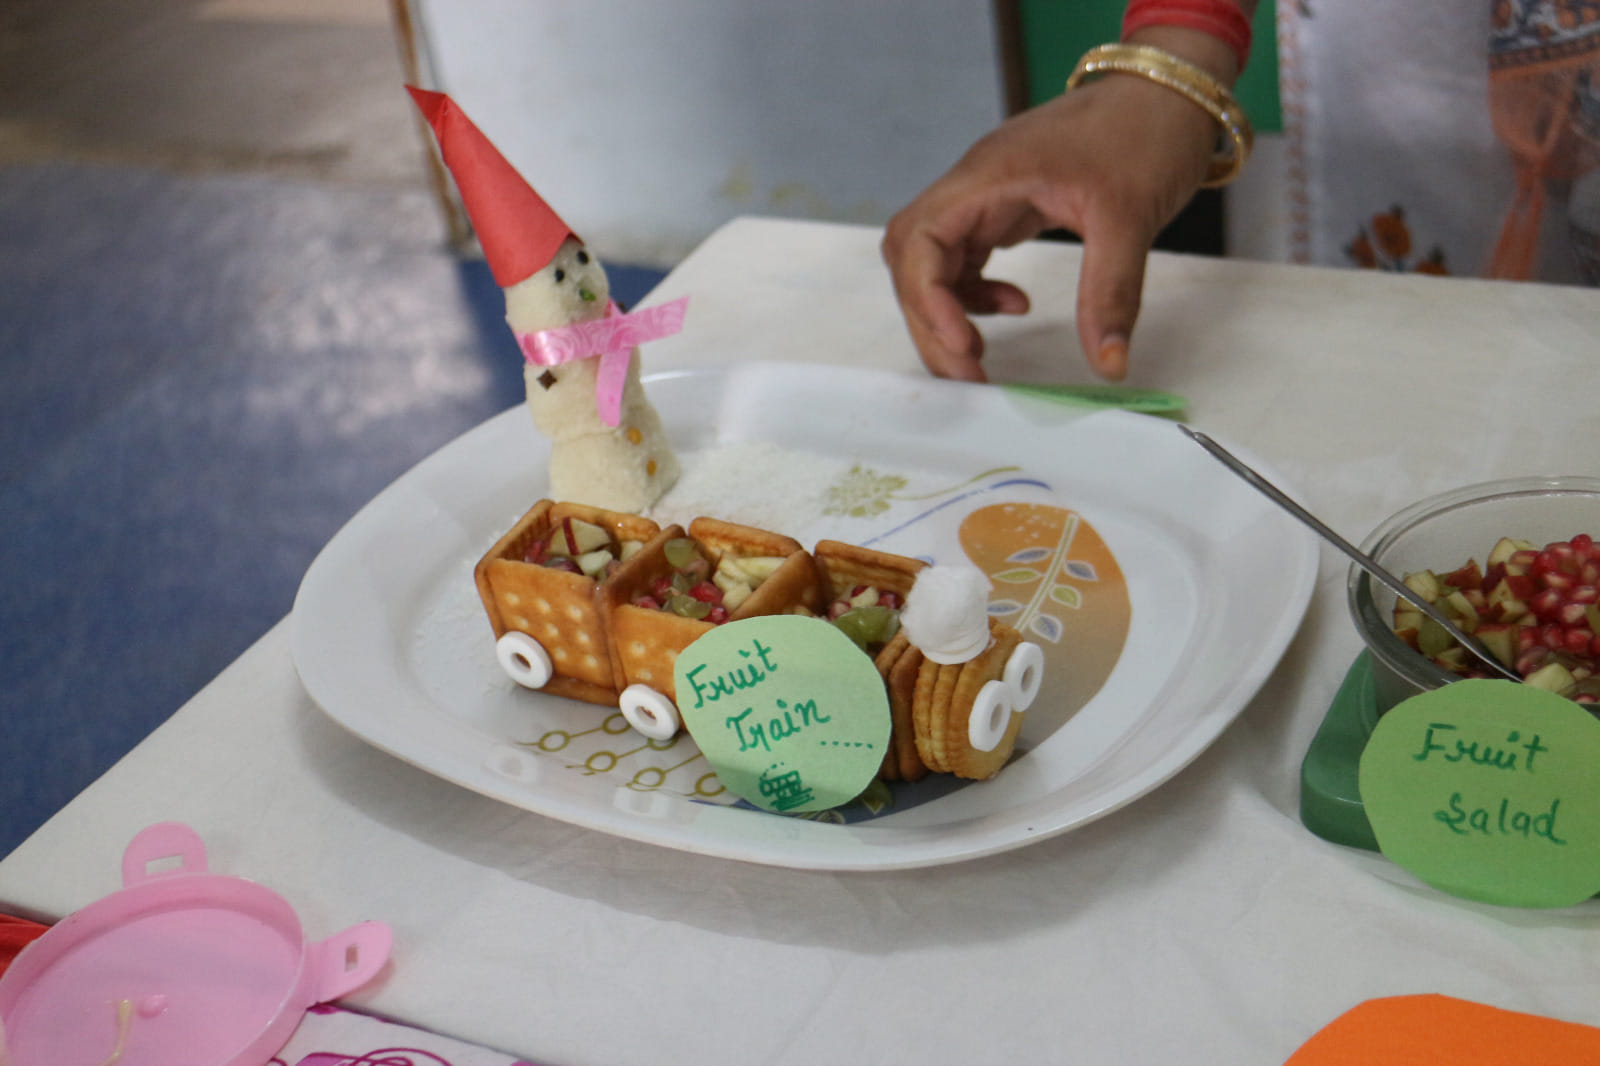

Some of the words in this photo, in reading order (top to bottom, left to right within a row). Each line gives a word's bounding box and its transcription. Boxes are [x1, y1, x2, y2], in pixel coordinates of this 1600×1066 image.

[686, 639, 777, 708] Fruit
[726, 699, 831, 752] Train
[1412, 722, 1549, 773] Fruit
[1433, 792, 1568, 845] Salad
